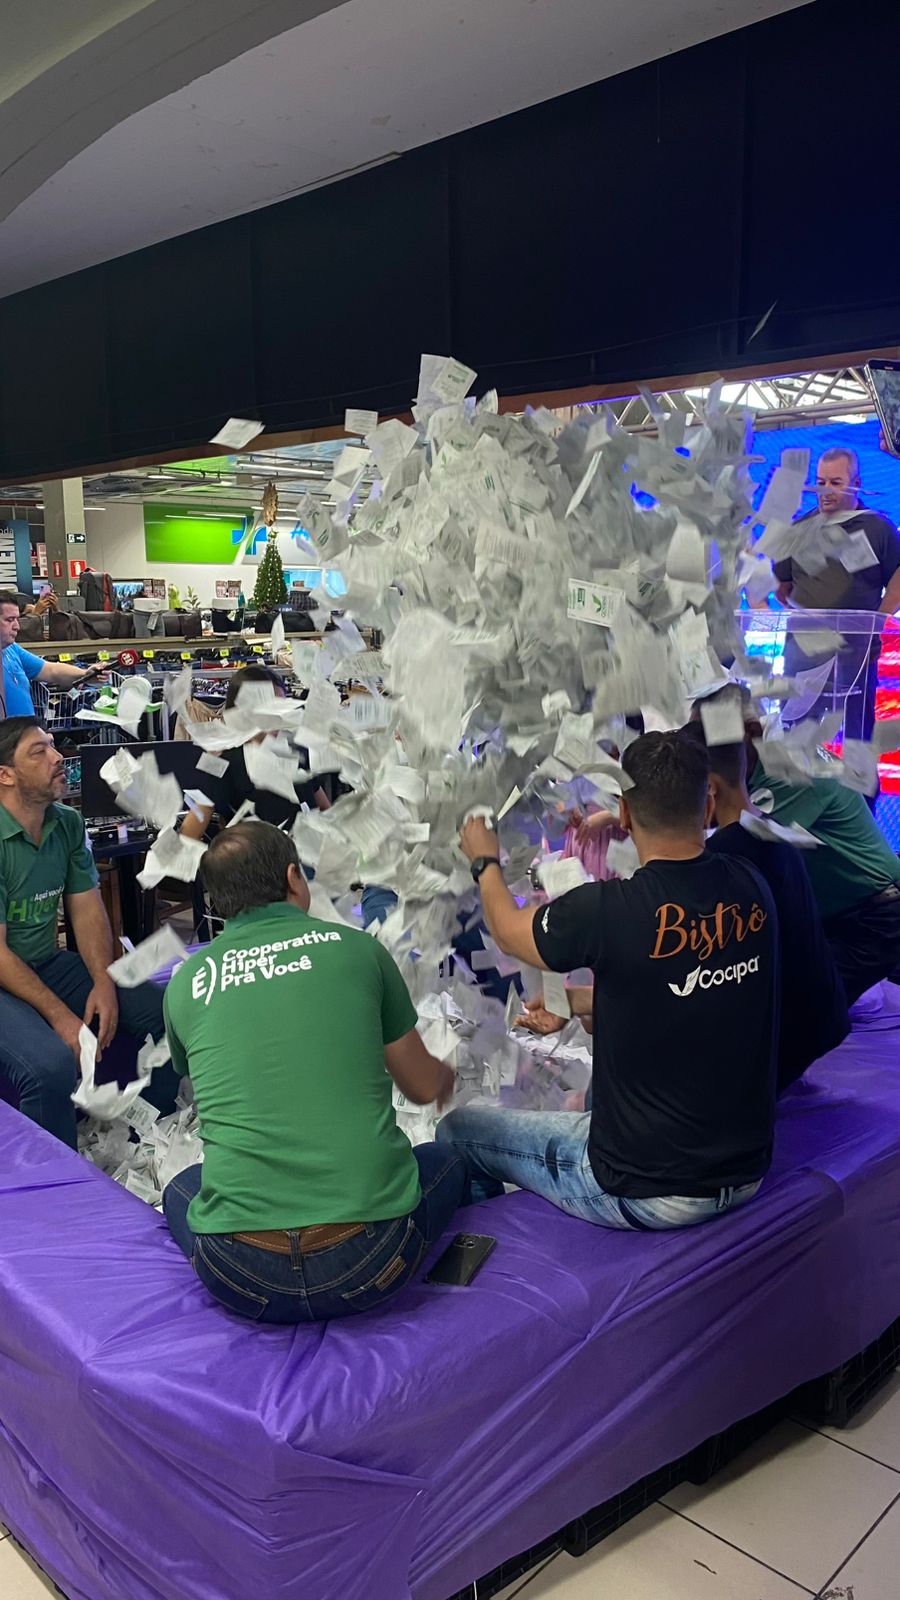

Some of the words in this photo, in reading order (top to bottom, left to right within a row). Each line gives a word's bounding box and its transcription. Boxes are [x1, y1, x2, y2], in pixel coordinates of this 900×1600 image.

[222, 930, 342, 963] Cooperativa
[649, 903, 767, 960] Bistrô
[220, 972, 256, 992] Pra
[260, 955, 312, 980] Você
[221, 954, 278, 976] Hiper
